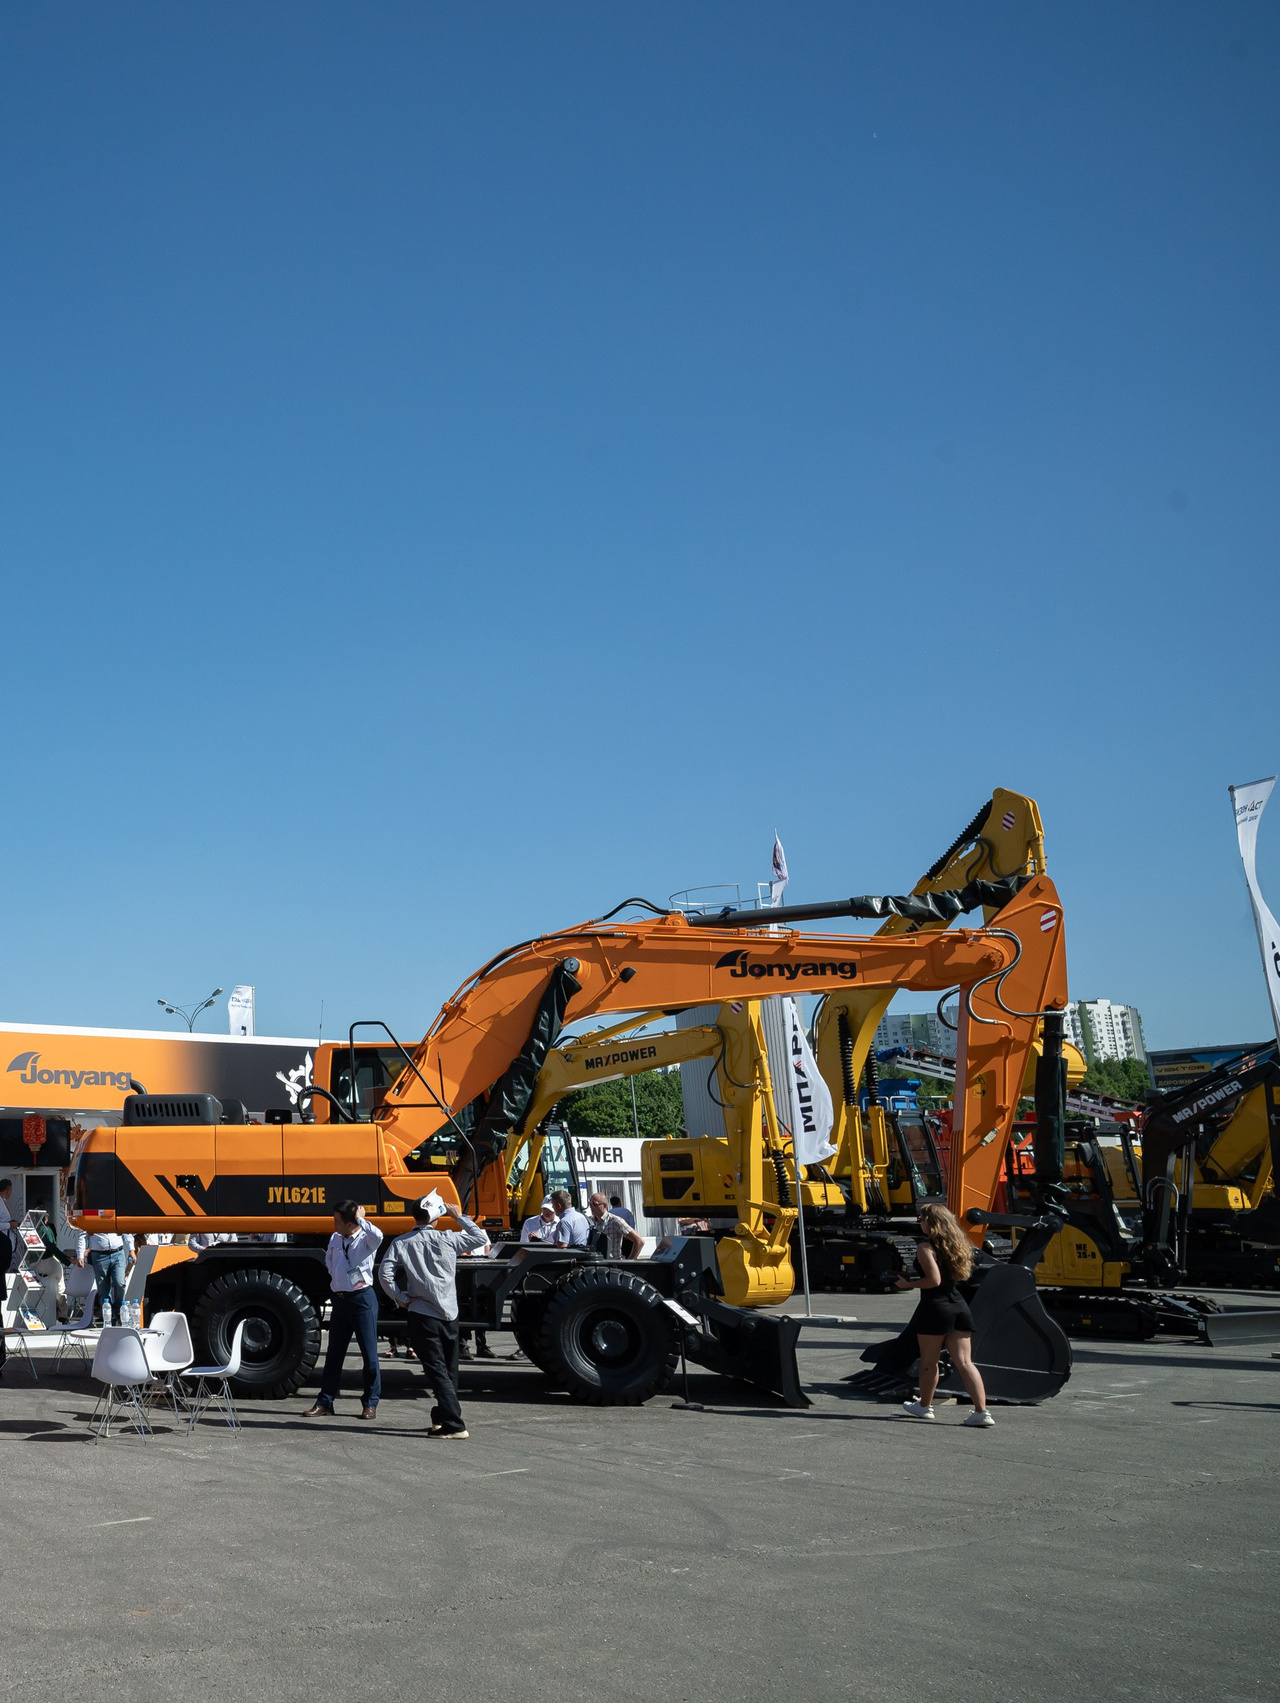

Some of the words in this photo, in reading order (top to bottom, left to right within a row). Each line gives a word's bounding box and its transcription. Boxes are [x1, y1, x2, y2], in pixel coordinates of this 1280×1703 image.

[730, 951, 857, 980] Jonyang
[585, 1046, 657, 1070] MAXPOWER
[1155, 1065, 1205, 1073] VEKTOR
[20, 1055, 132, 1091] Jonyang
[268, 1187, 326, 1203] JYL621E
